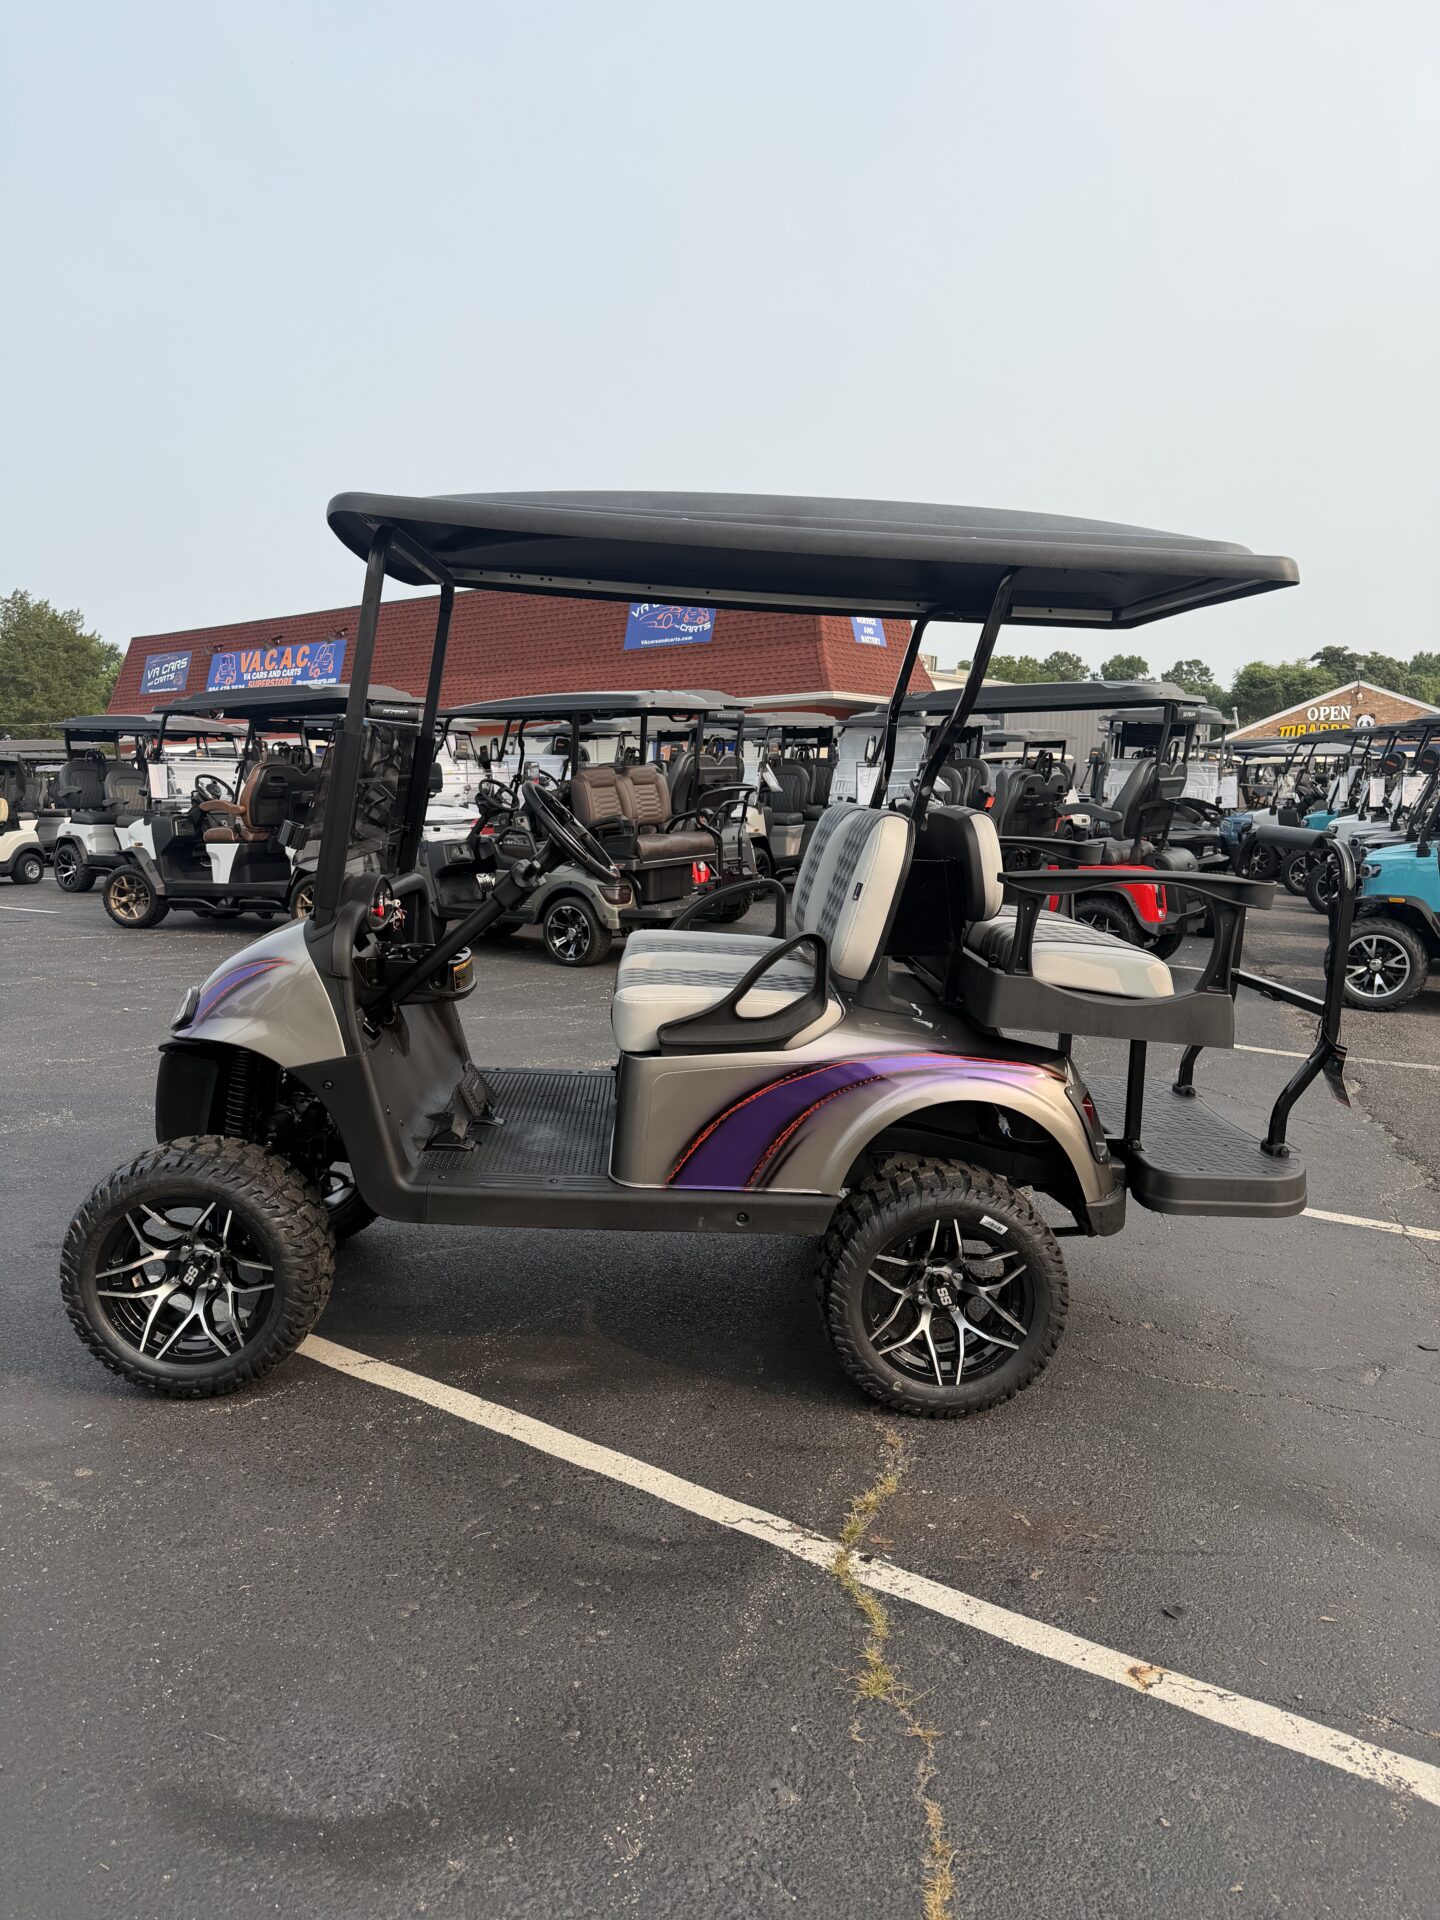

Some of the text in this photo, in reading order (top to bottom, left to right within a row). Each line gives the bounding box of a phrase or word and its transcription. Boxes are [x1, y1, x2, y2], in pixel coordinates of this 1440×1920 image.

[680, 621, 711, 633] CARTS
[147, 657, 189, 680] VA CARS
[251, 670, 268, 680] CARS
[267, 669, 282, 678] AND
[281, 667, 302, 677] CARTS
[153, 672, 176, 686] CARTS
[247, 676, 294, 689] SUPERSTORE
[1307, 705, 1352, 721] OPEN
